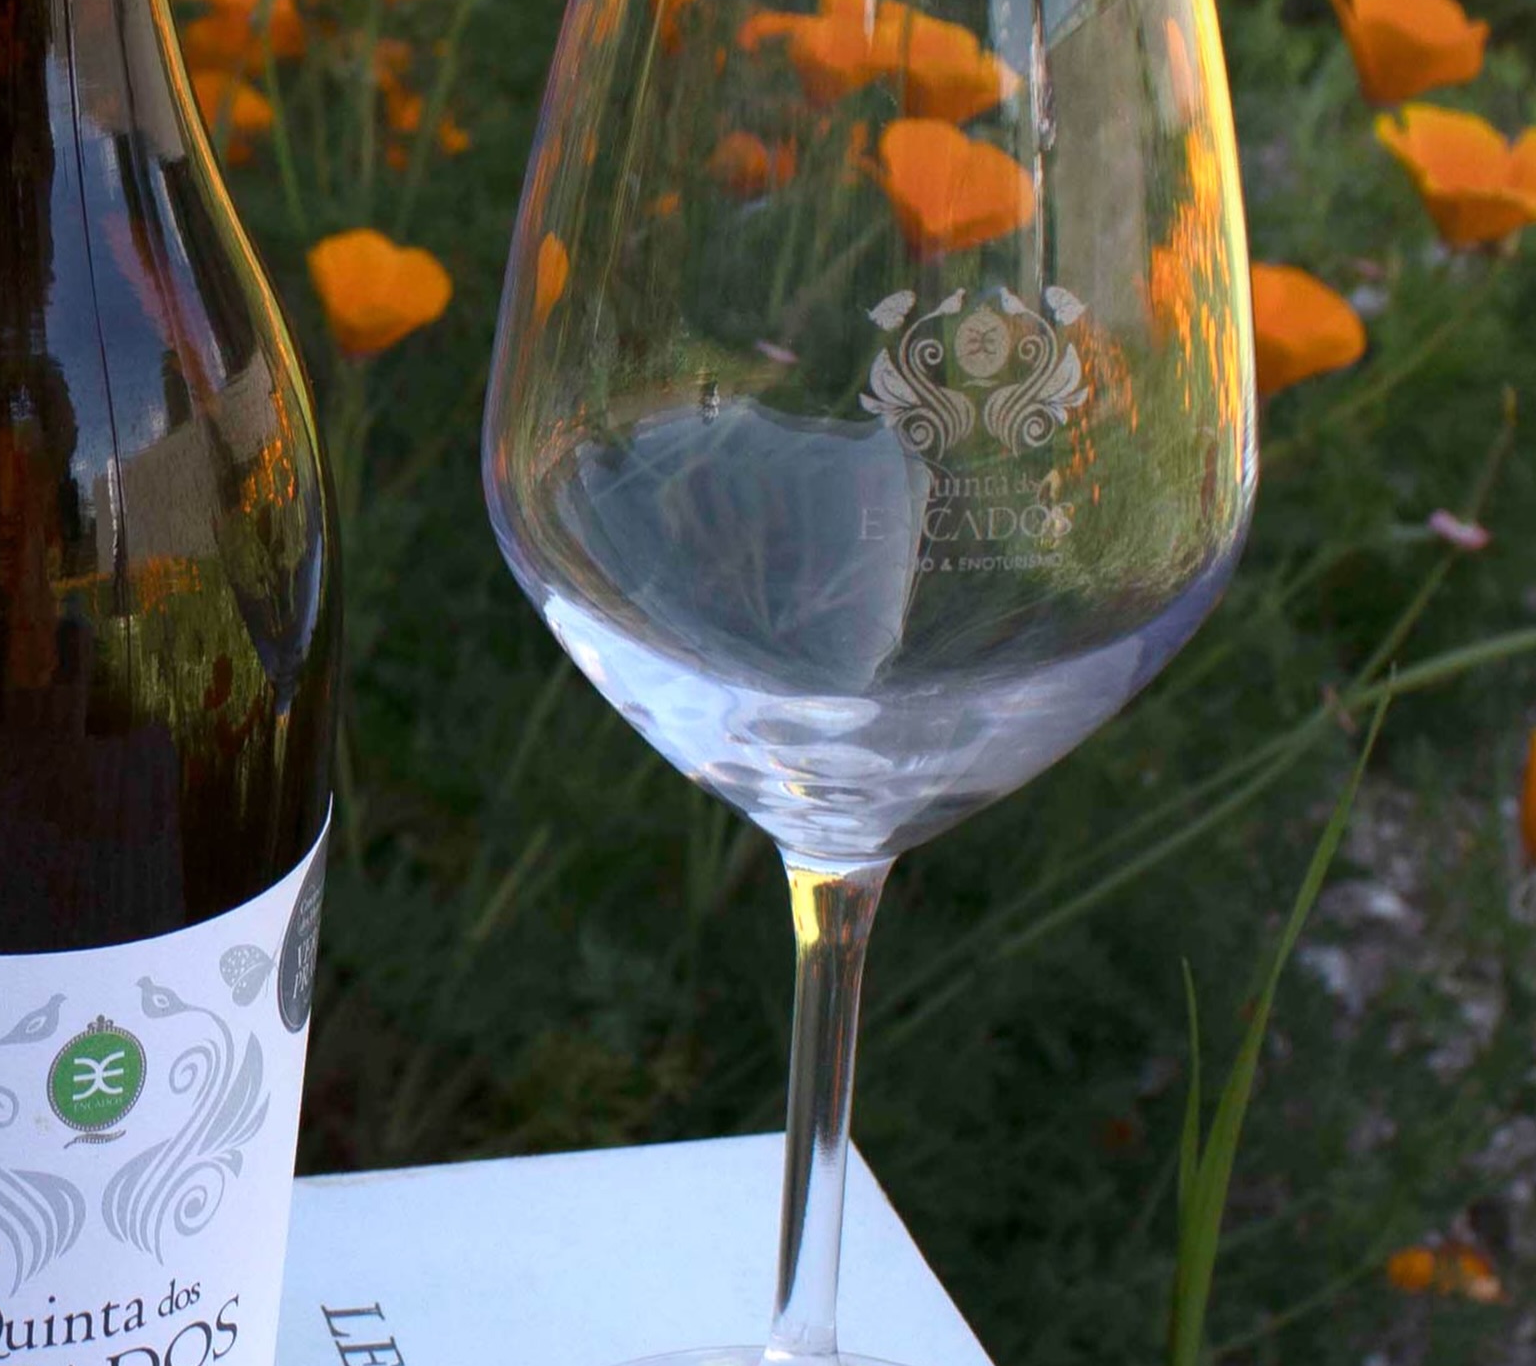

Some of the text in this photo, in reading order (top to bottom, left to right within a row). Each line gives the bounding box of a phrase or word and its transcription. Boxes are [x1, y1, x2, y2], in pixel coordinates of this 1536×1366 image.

[915, 472, 1008, 502] uinta
[857, 501, 1074, 542] ECADOS
[158, 1279, 201, 1320] dos
